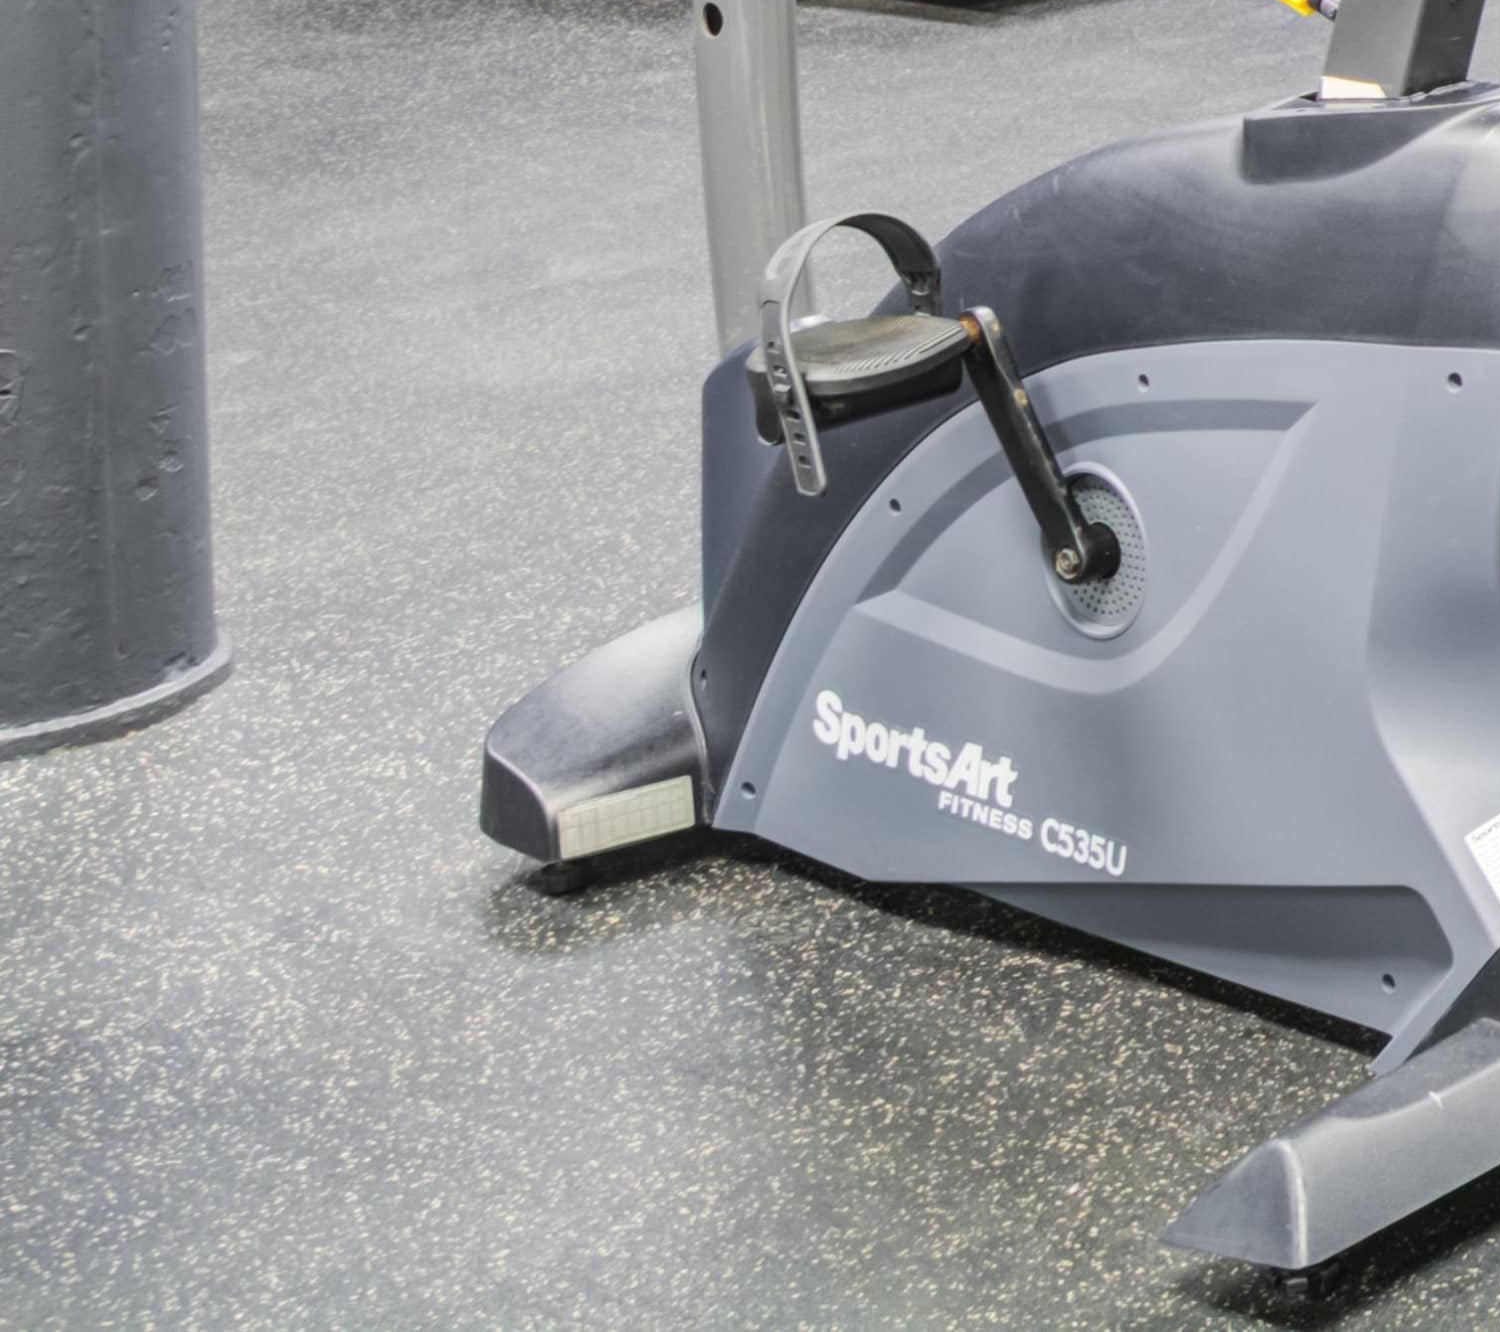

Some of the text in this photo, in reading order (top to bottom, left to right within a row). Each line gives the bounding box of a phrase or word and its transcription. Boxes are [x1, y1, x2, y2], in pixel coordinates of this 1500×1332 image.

[812, 689, 1019, 808] SportsArt
[937, 790, 1128, 877] FITNESS C535U
